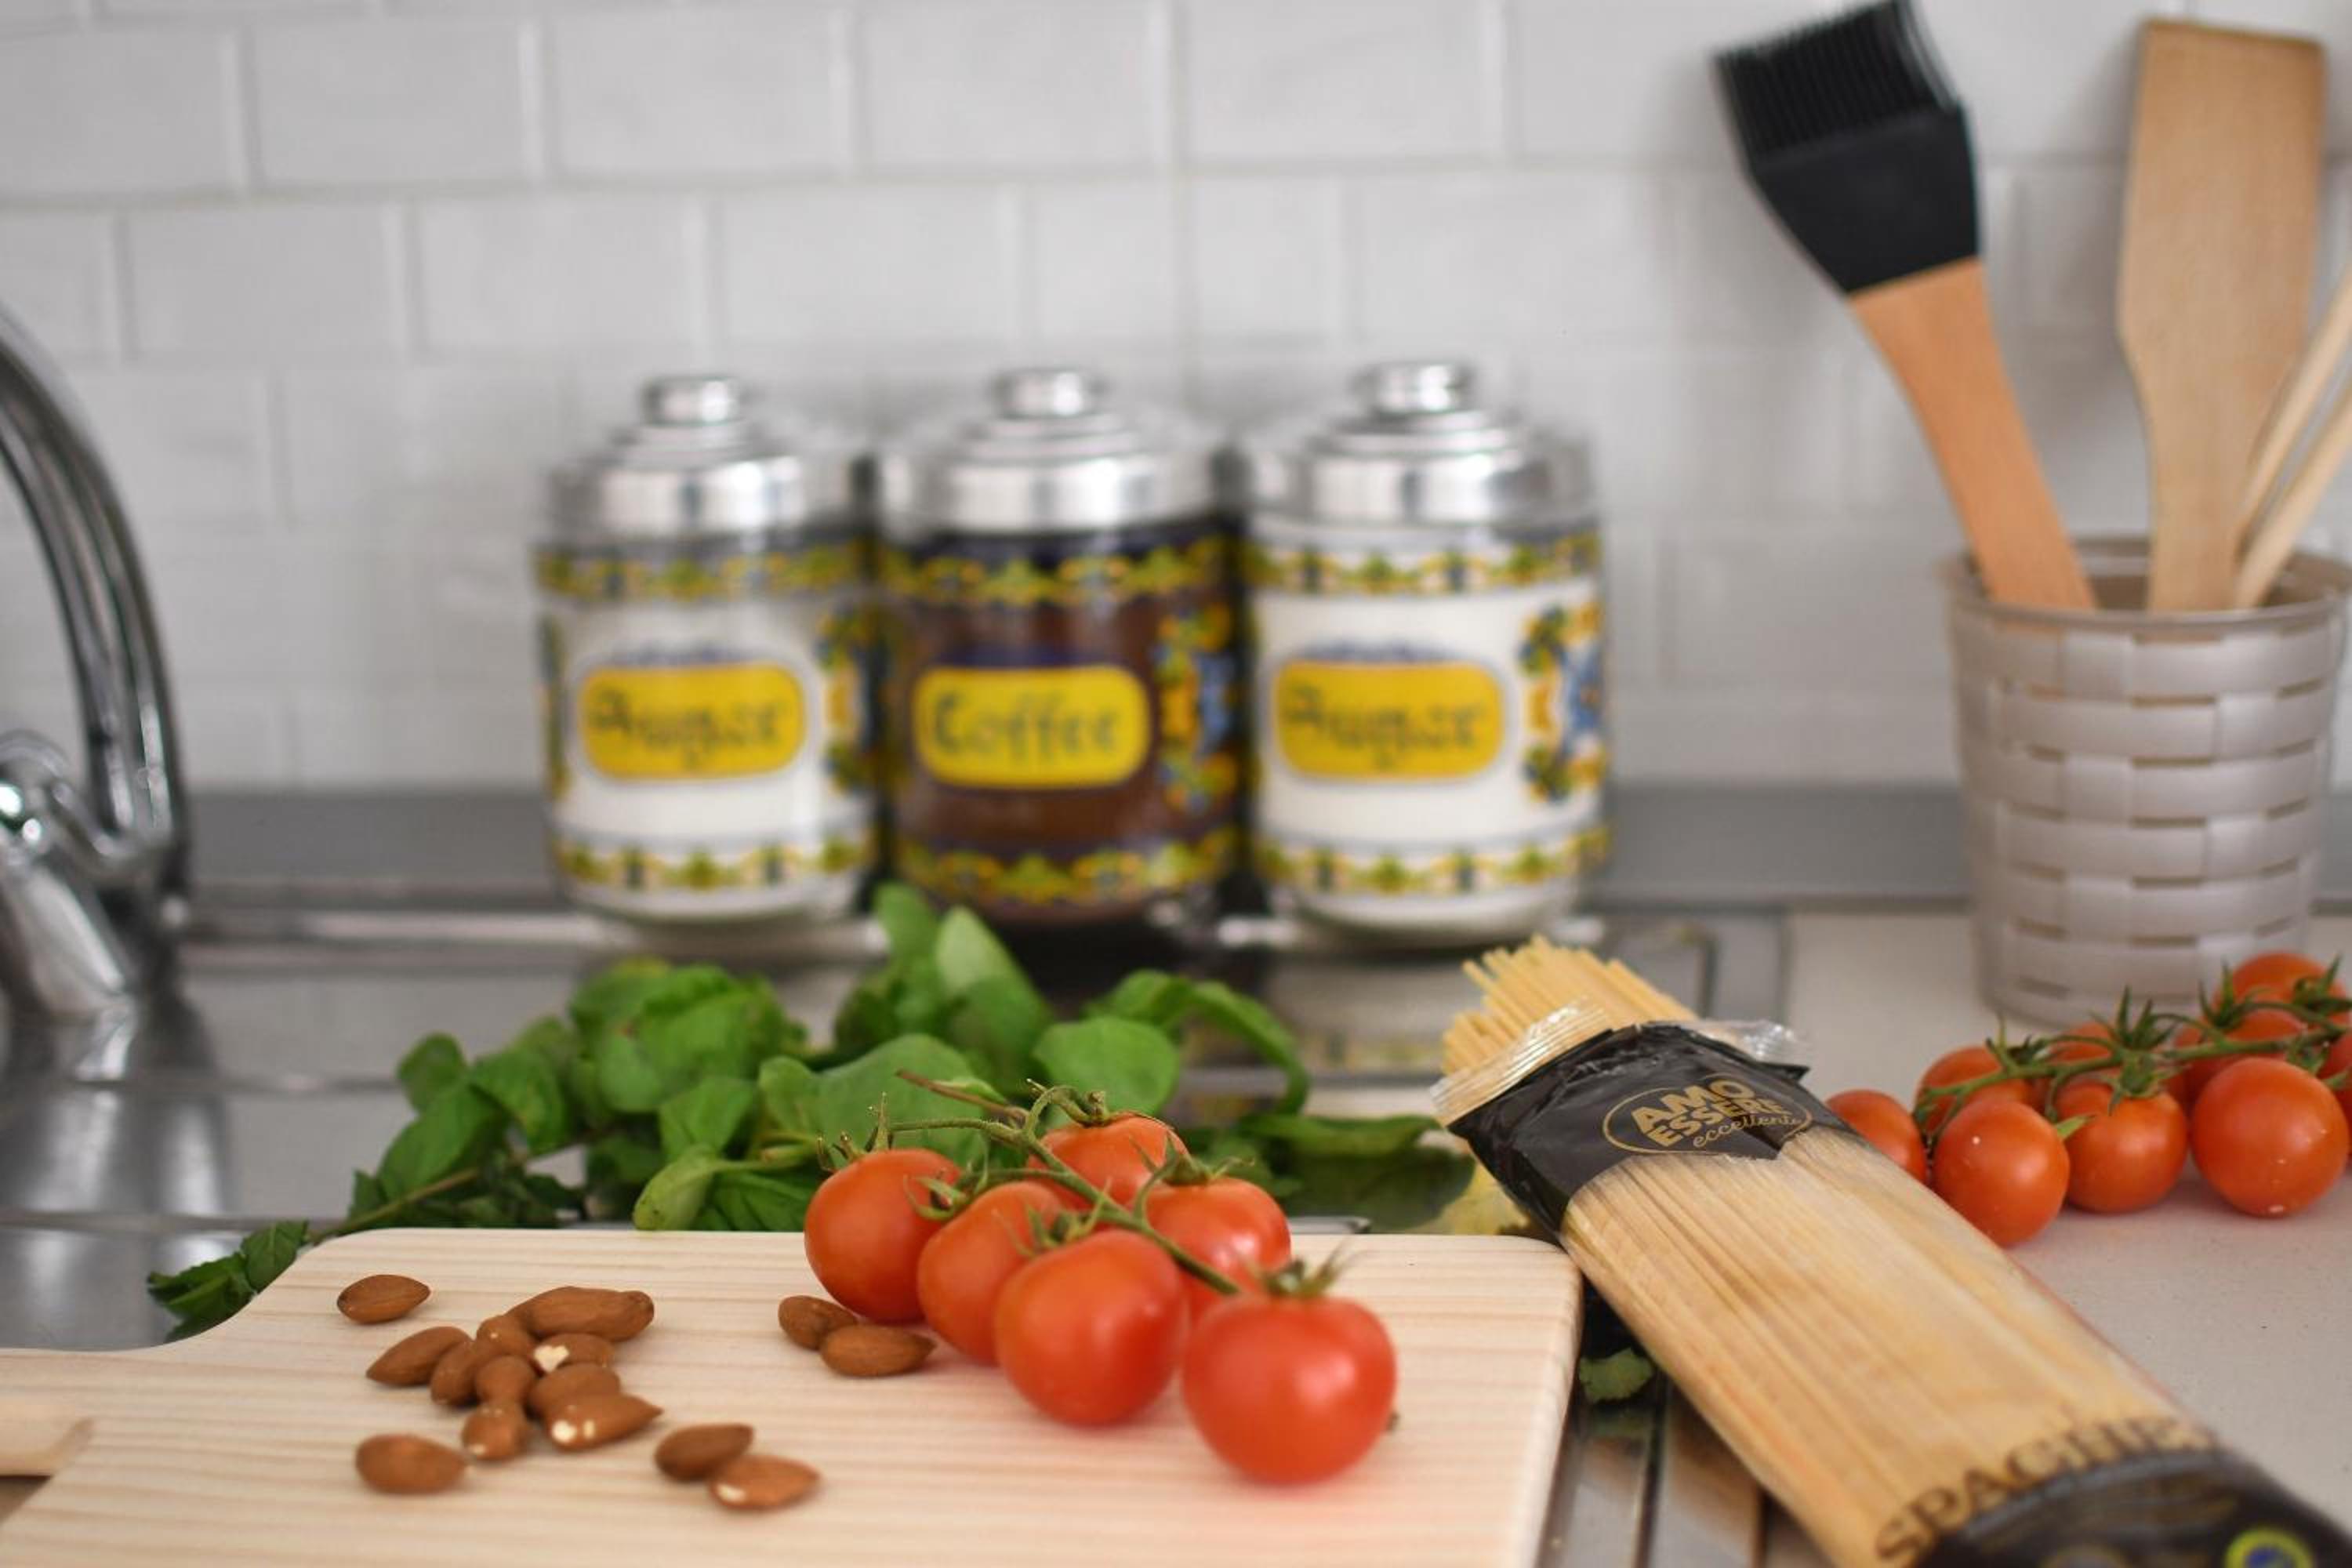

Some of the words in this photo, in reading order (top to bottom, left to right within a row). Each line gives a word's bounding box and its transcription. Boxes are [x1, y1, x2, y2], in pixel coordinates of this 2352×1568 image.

[933, 691, 1120, 762] Coffee
[1631, 1080, 1755, 1134] AMO
[1648, 1098, 1793, 1147] ESSERE
